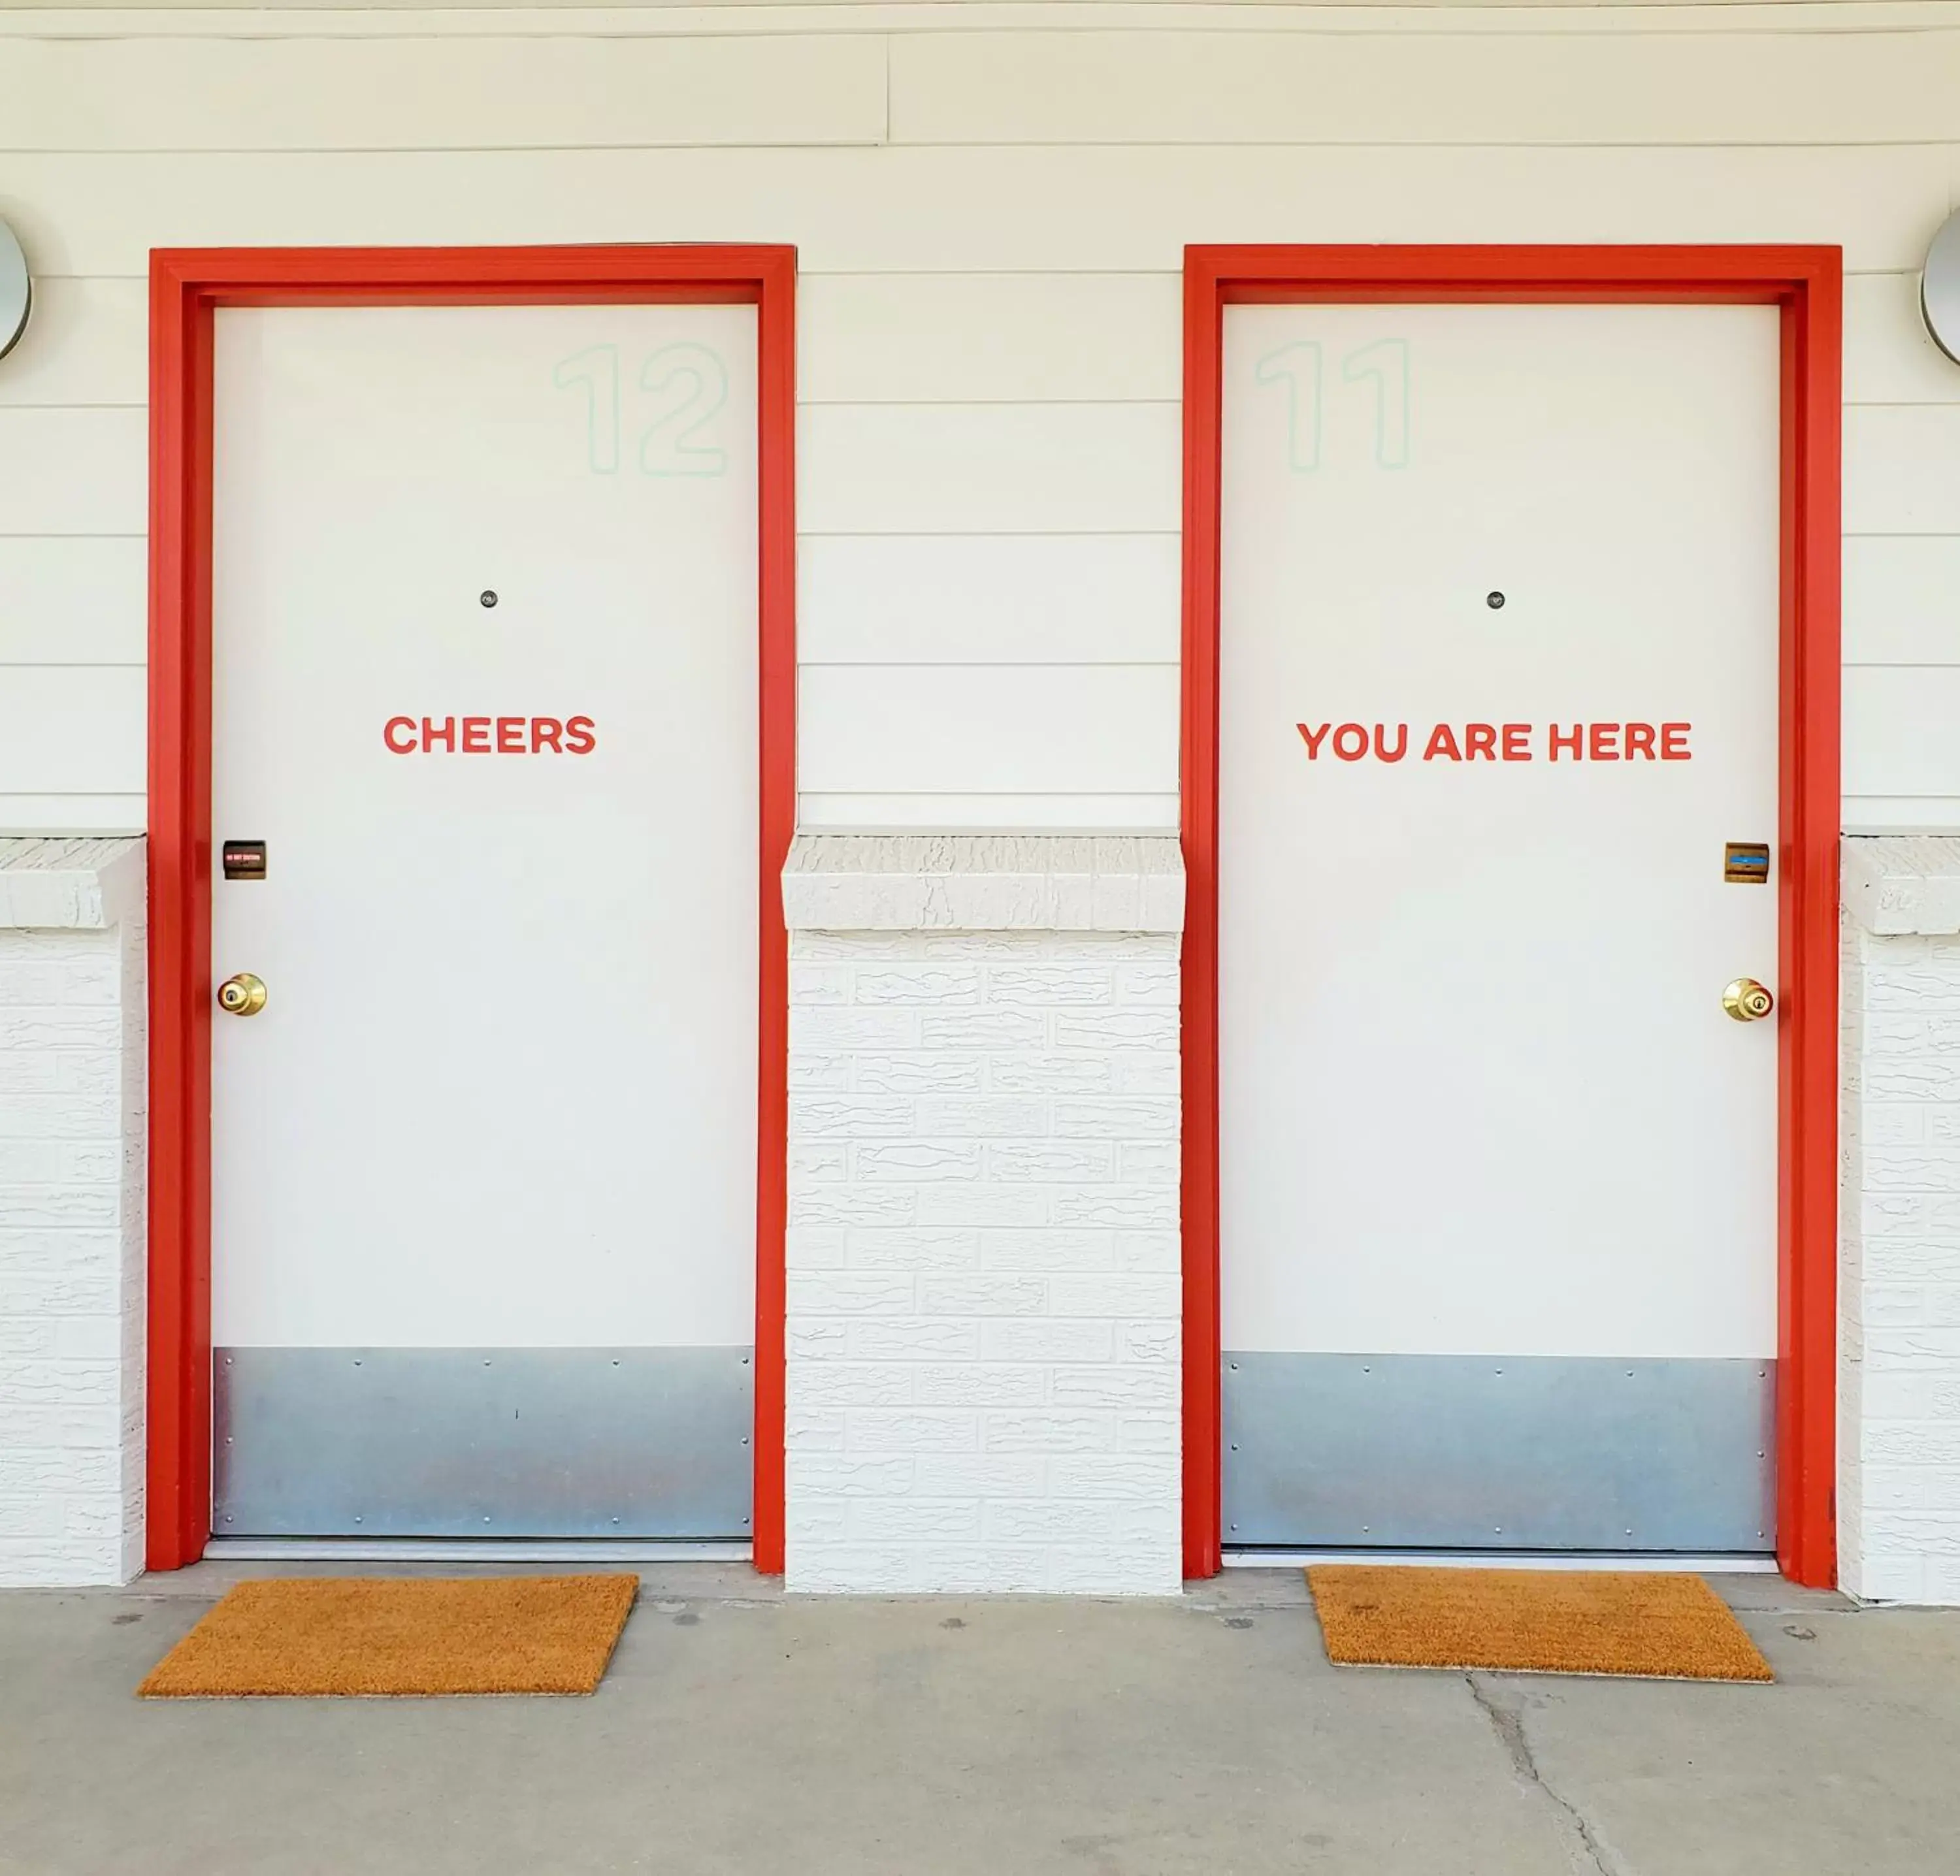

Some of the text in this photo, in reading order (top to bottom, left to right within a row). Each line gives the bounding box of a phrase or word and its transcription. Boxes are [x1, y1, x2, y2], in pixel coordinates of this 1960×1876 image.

[553, 342, 728, 477] 12
[1255, 338, 1409, 472] 11
[384, 716, 596, 754] CHEERS
[1296, 722, 1692, 763] YOU ARE HERE
